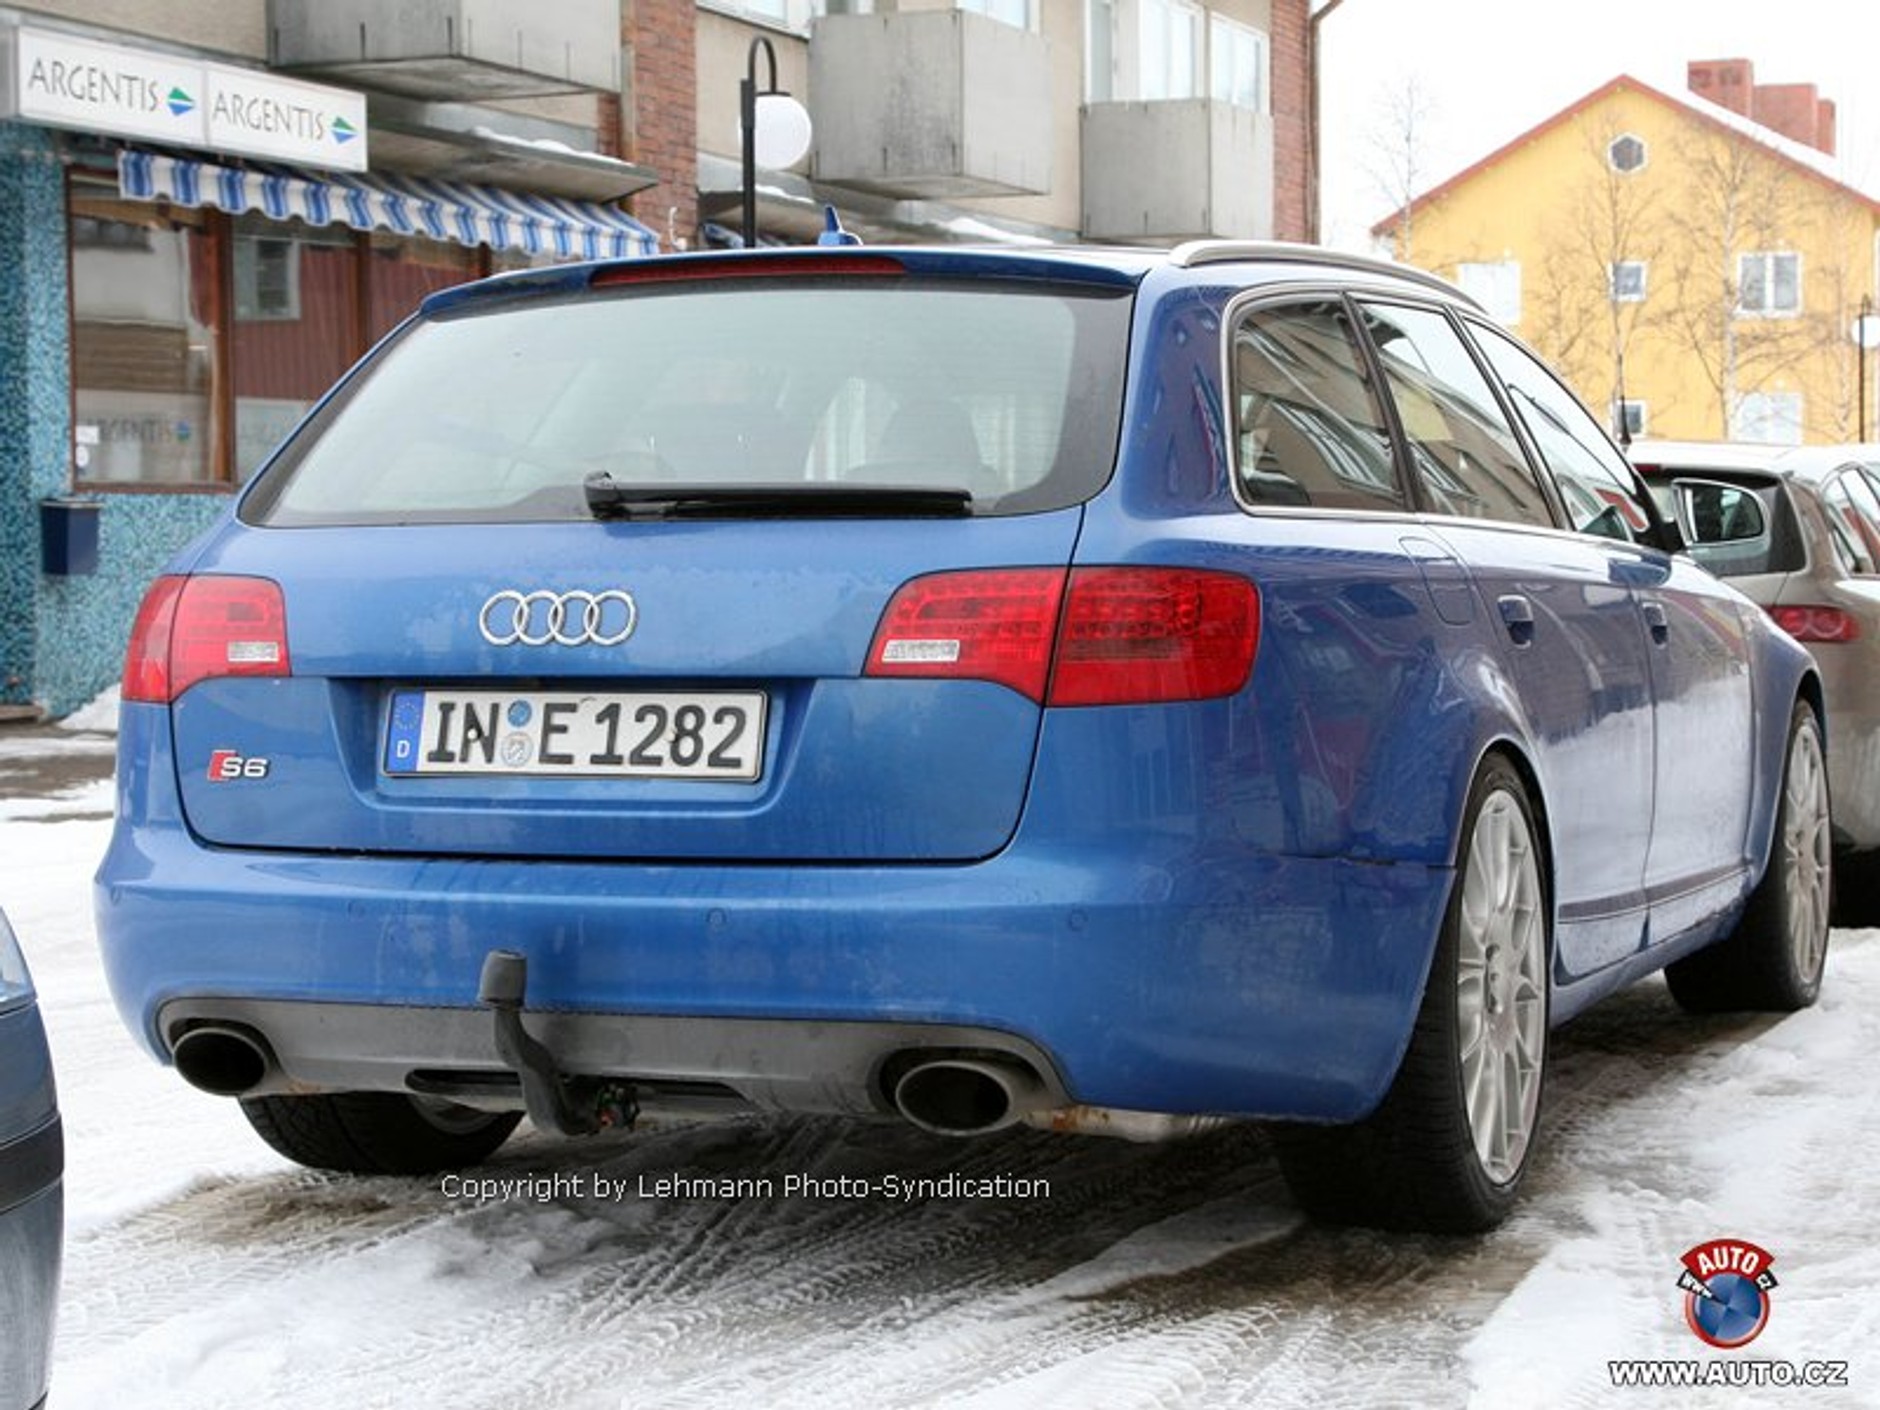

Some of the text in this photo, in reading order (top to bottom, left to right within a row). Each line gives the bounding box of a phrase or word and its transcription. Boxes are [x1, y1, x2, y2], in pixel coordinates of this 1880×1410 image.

[28, 58, 158, 113] ARGENTIS
[212, 91, 324, 141] ARGENTIS
[396, 740, 410, 758] D
[427, 702, 500, 763] IN
[221, 757, 268, 777] S6
